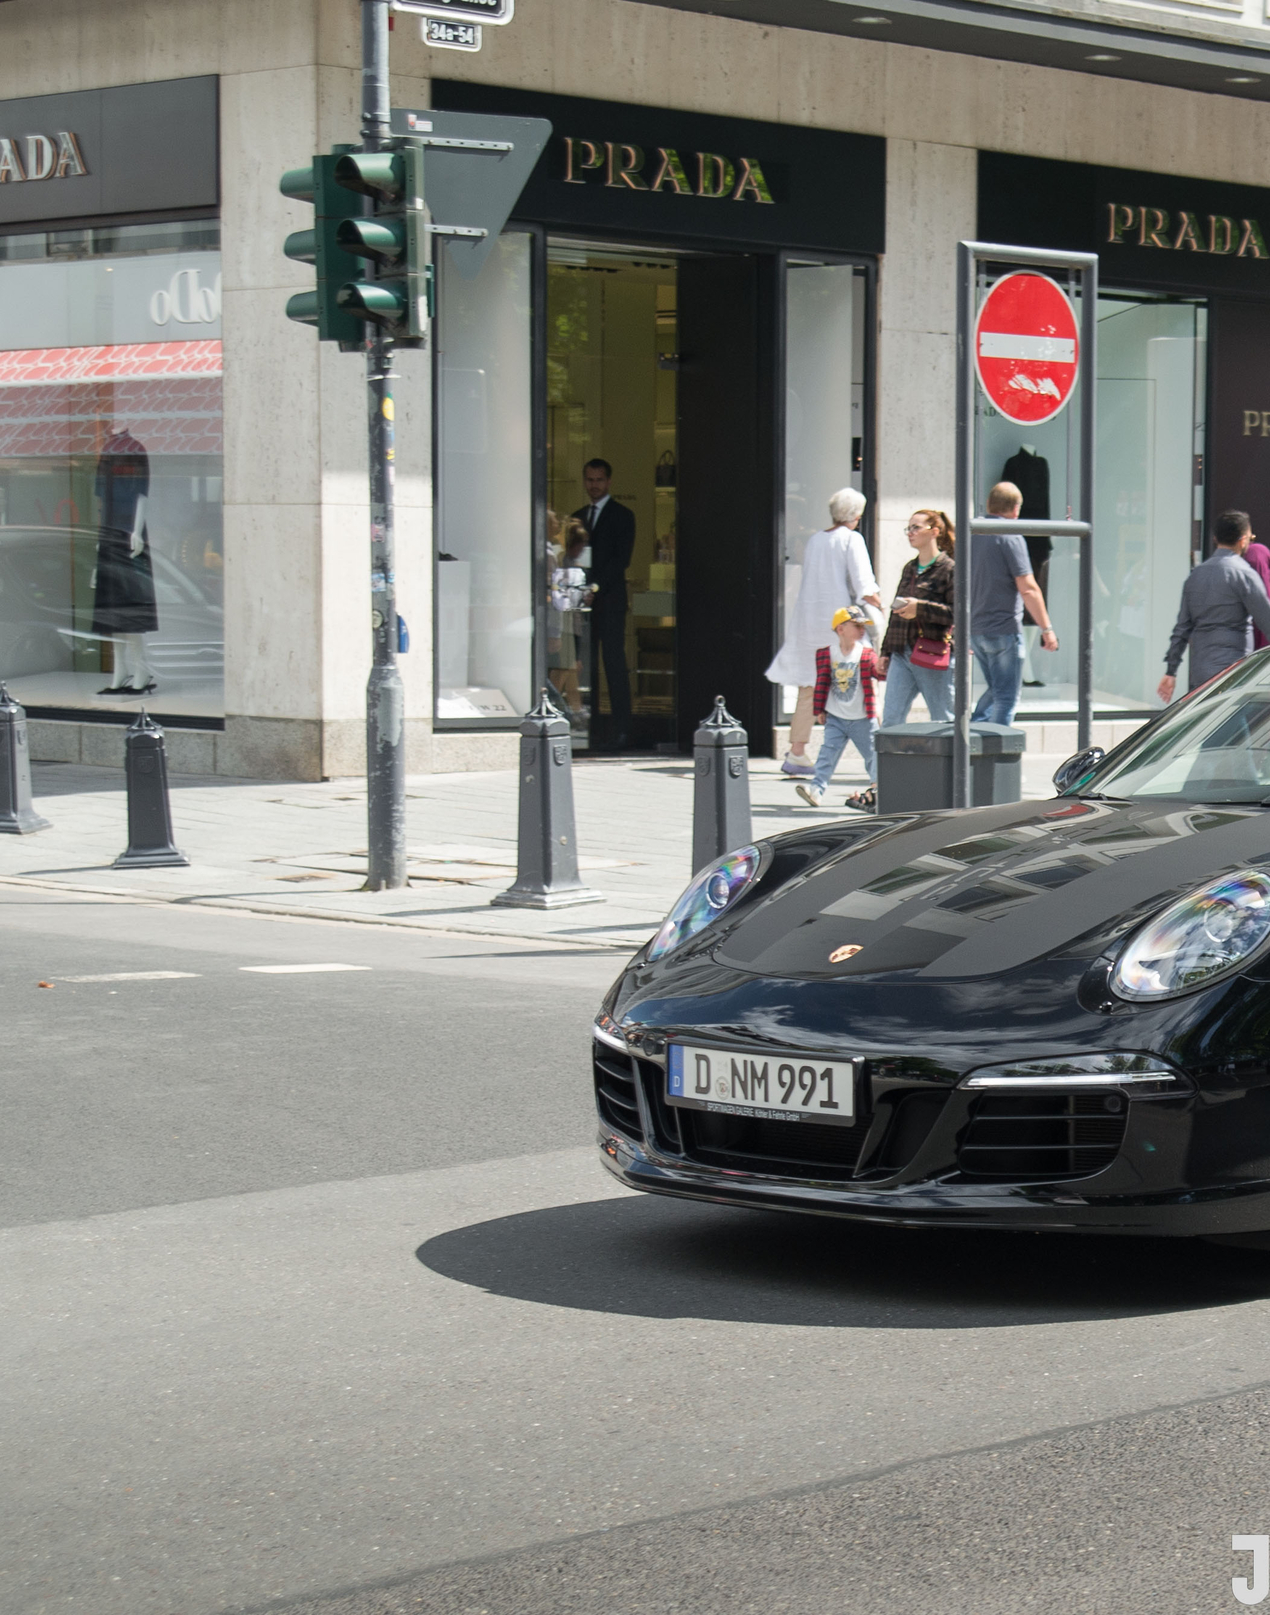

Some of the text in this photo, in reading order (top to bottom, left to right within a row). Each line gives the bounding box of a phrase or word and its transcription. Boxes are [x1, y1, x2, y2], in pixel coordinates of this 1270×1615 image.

[431, 23, 474, 44] 34a-54
[564, 137, 775, 204] PRADA
[1107, 203, 1270, 259] PRADA
[673, 1075, 681, 1088] D
[695, 1053, 839, 1110] D NM 991
